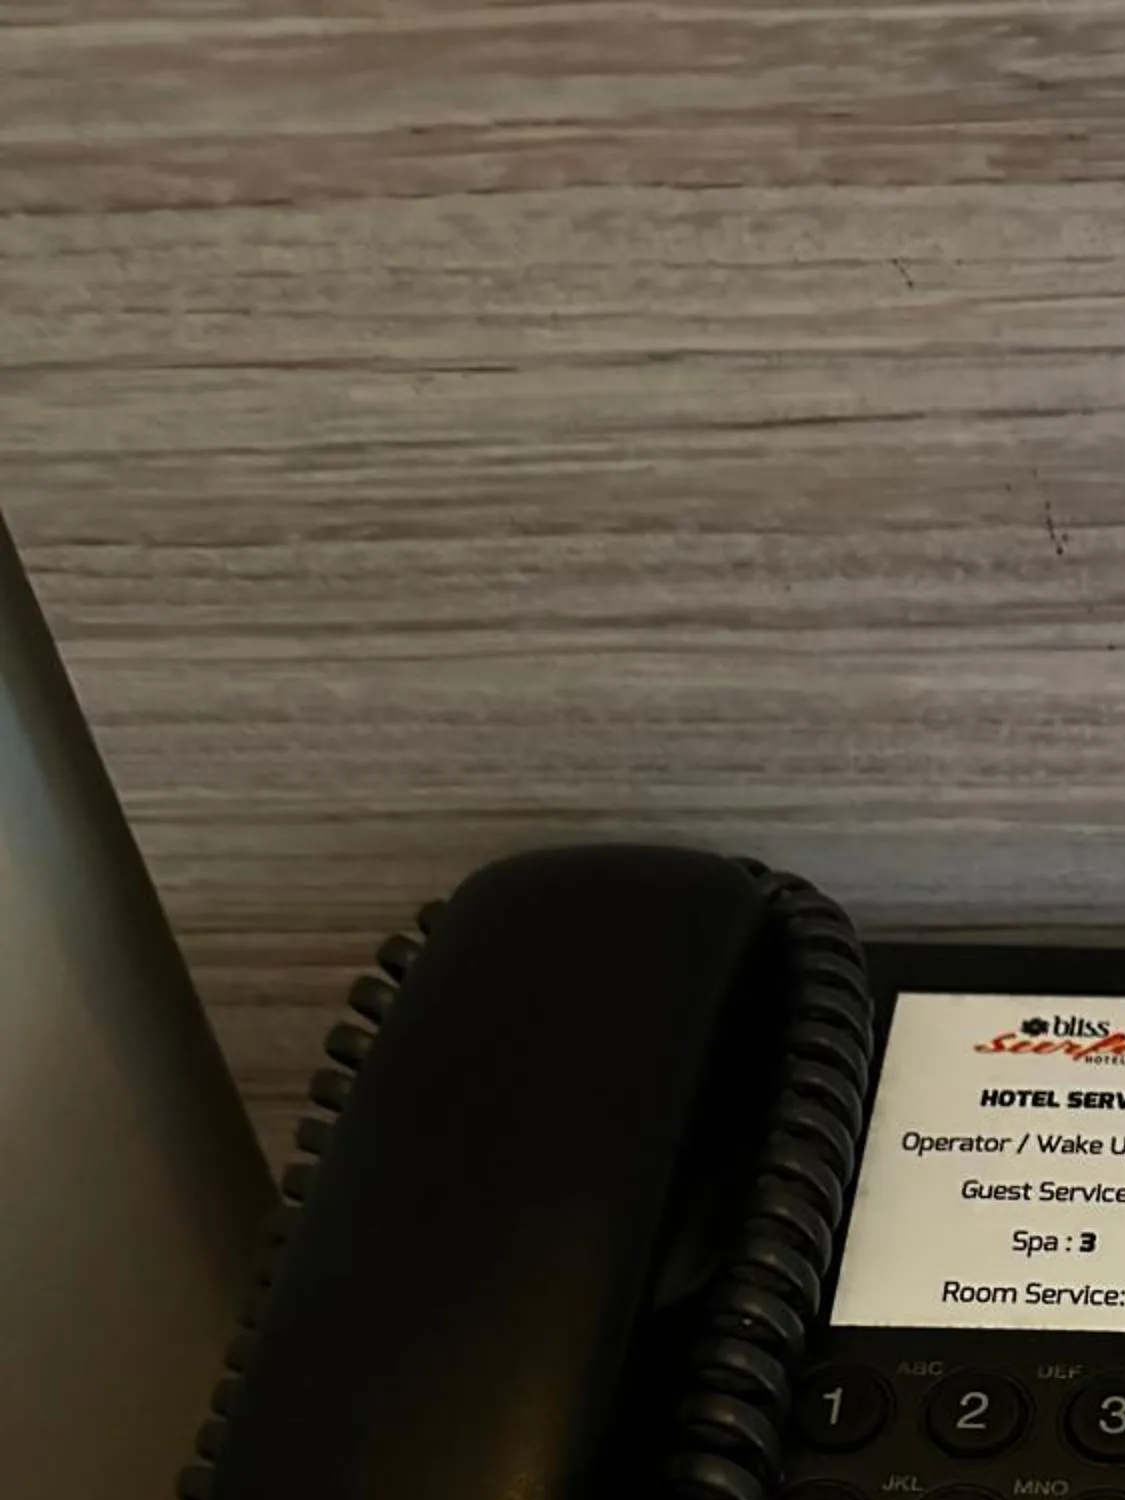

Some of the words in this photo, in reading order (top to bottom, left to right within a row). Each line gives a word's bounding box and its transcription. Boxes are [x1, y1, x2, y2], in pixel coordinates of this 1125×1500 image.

[1053, 1015, 1110, 1037] bliss
[1085, 1054, 1125, 1065] HOTEL
[980, 1089, 1060, 1108] HOTEL
[901, 1131, 1010, 1154] Operator
[1016, 1134, 1029, 1153] /
[1038, 1134, 1103, 1154] Wake
[961, 1180, 1032, 1200] Guest
[1012, 1231, 1058, 1256] Spa
[1078, 1232, 1096, 1253] 3
[942, 1281, 1017, 1304] Room
[1025, 1285, 1125, 1306] Service:
[822, 1386, 844, 1426] 1
[955, 1390, 990, 1430] 2
[882, 1474, 924, 1493] JKL
[1013, 1480, 1071, 1497] MNO
